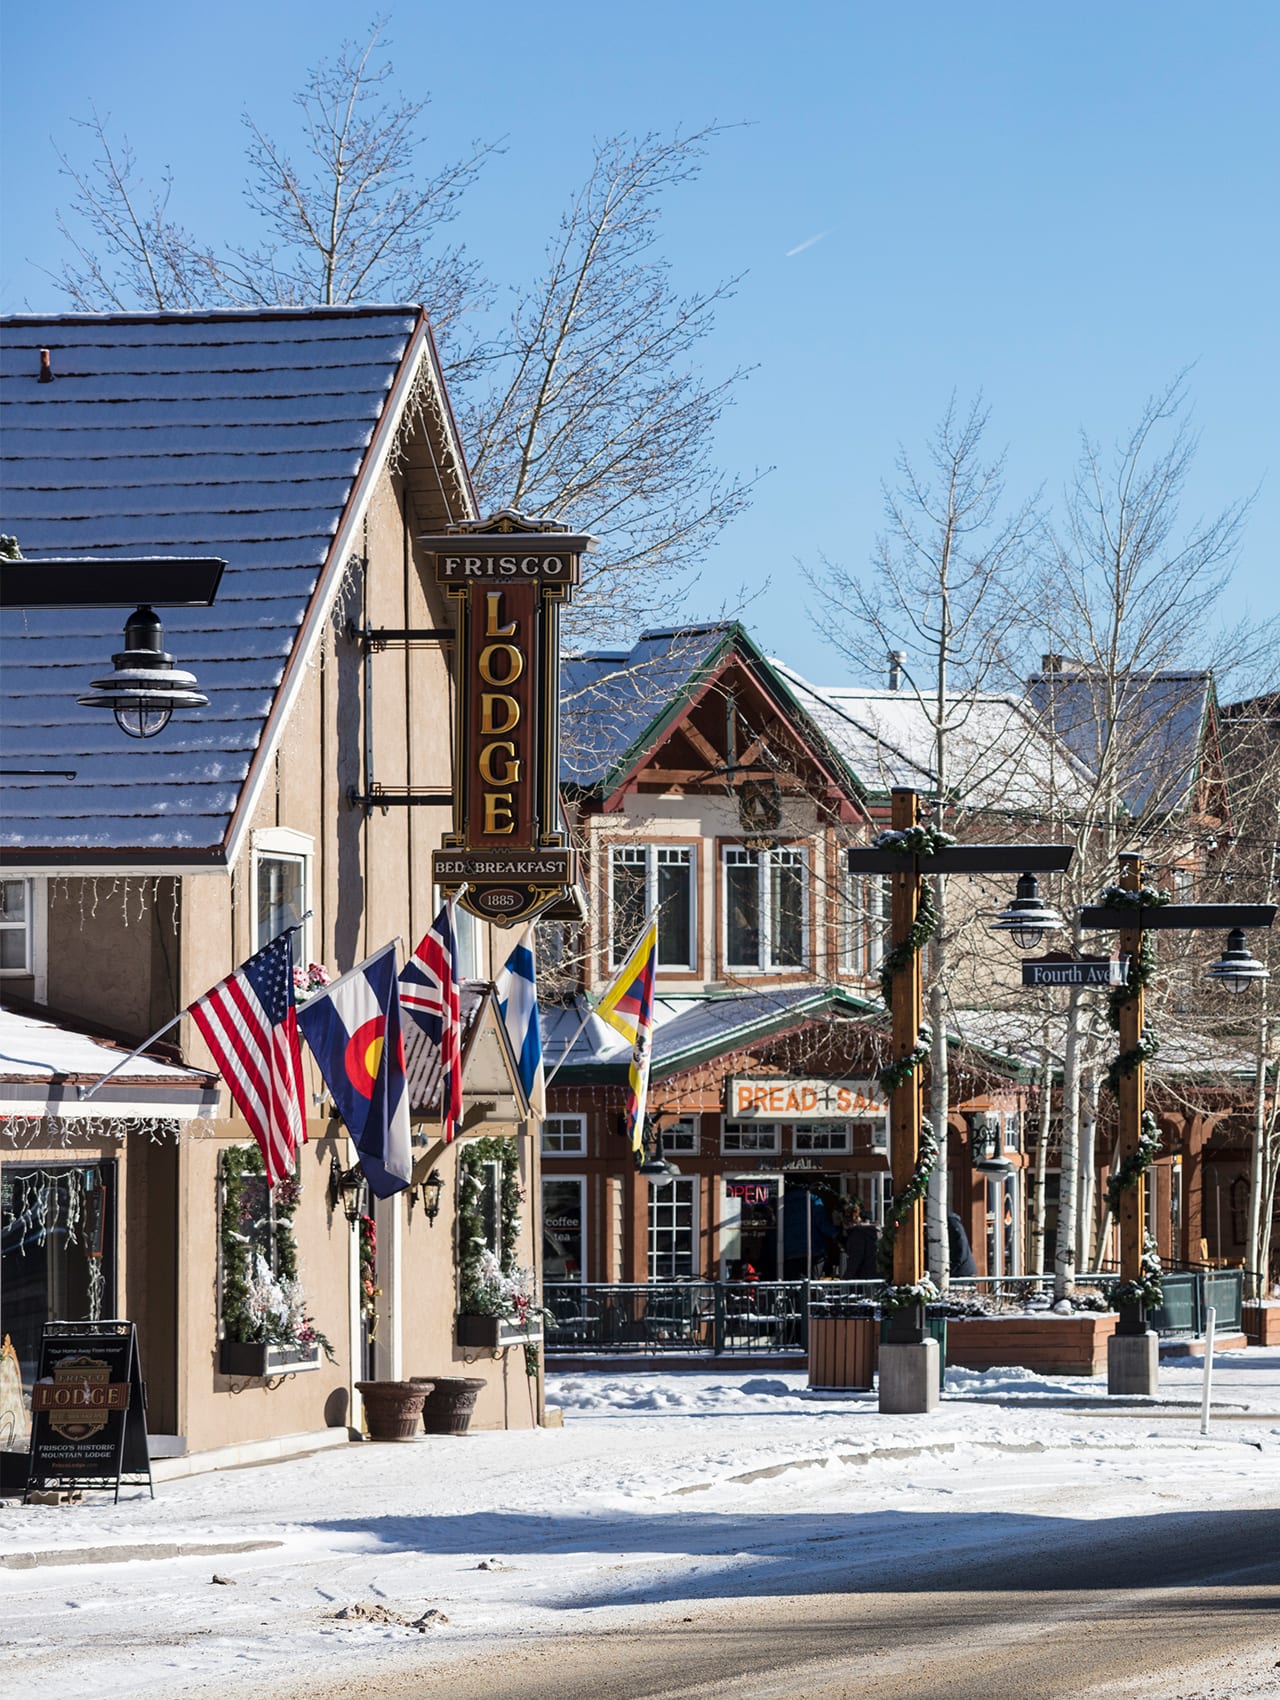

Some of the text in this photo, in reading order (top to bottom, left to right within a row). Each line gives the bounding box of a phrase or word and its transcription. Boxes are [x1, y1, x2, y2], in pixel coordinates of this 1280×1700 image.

[444, 556, 563, 576] FRISCO
[478, 591, 524, 835] LODGE
[434, 862, 465, 874] BED
[475, 861, 566, 873] BREAKFAST
[487, 895, 514, 906] 1885
[1033, 965, 1111, 983] Fourth Ave
[545, 1216, 579, 1227] coffee
[554, 1233, 571, 1241] tea
[42, 1388, 119, 1405] LODGE
